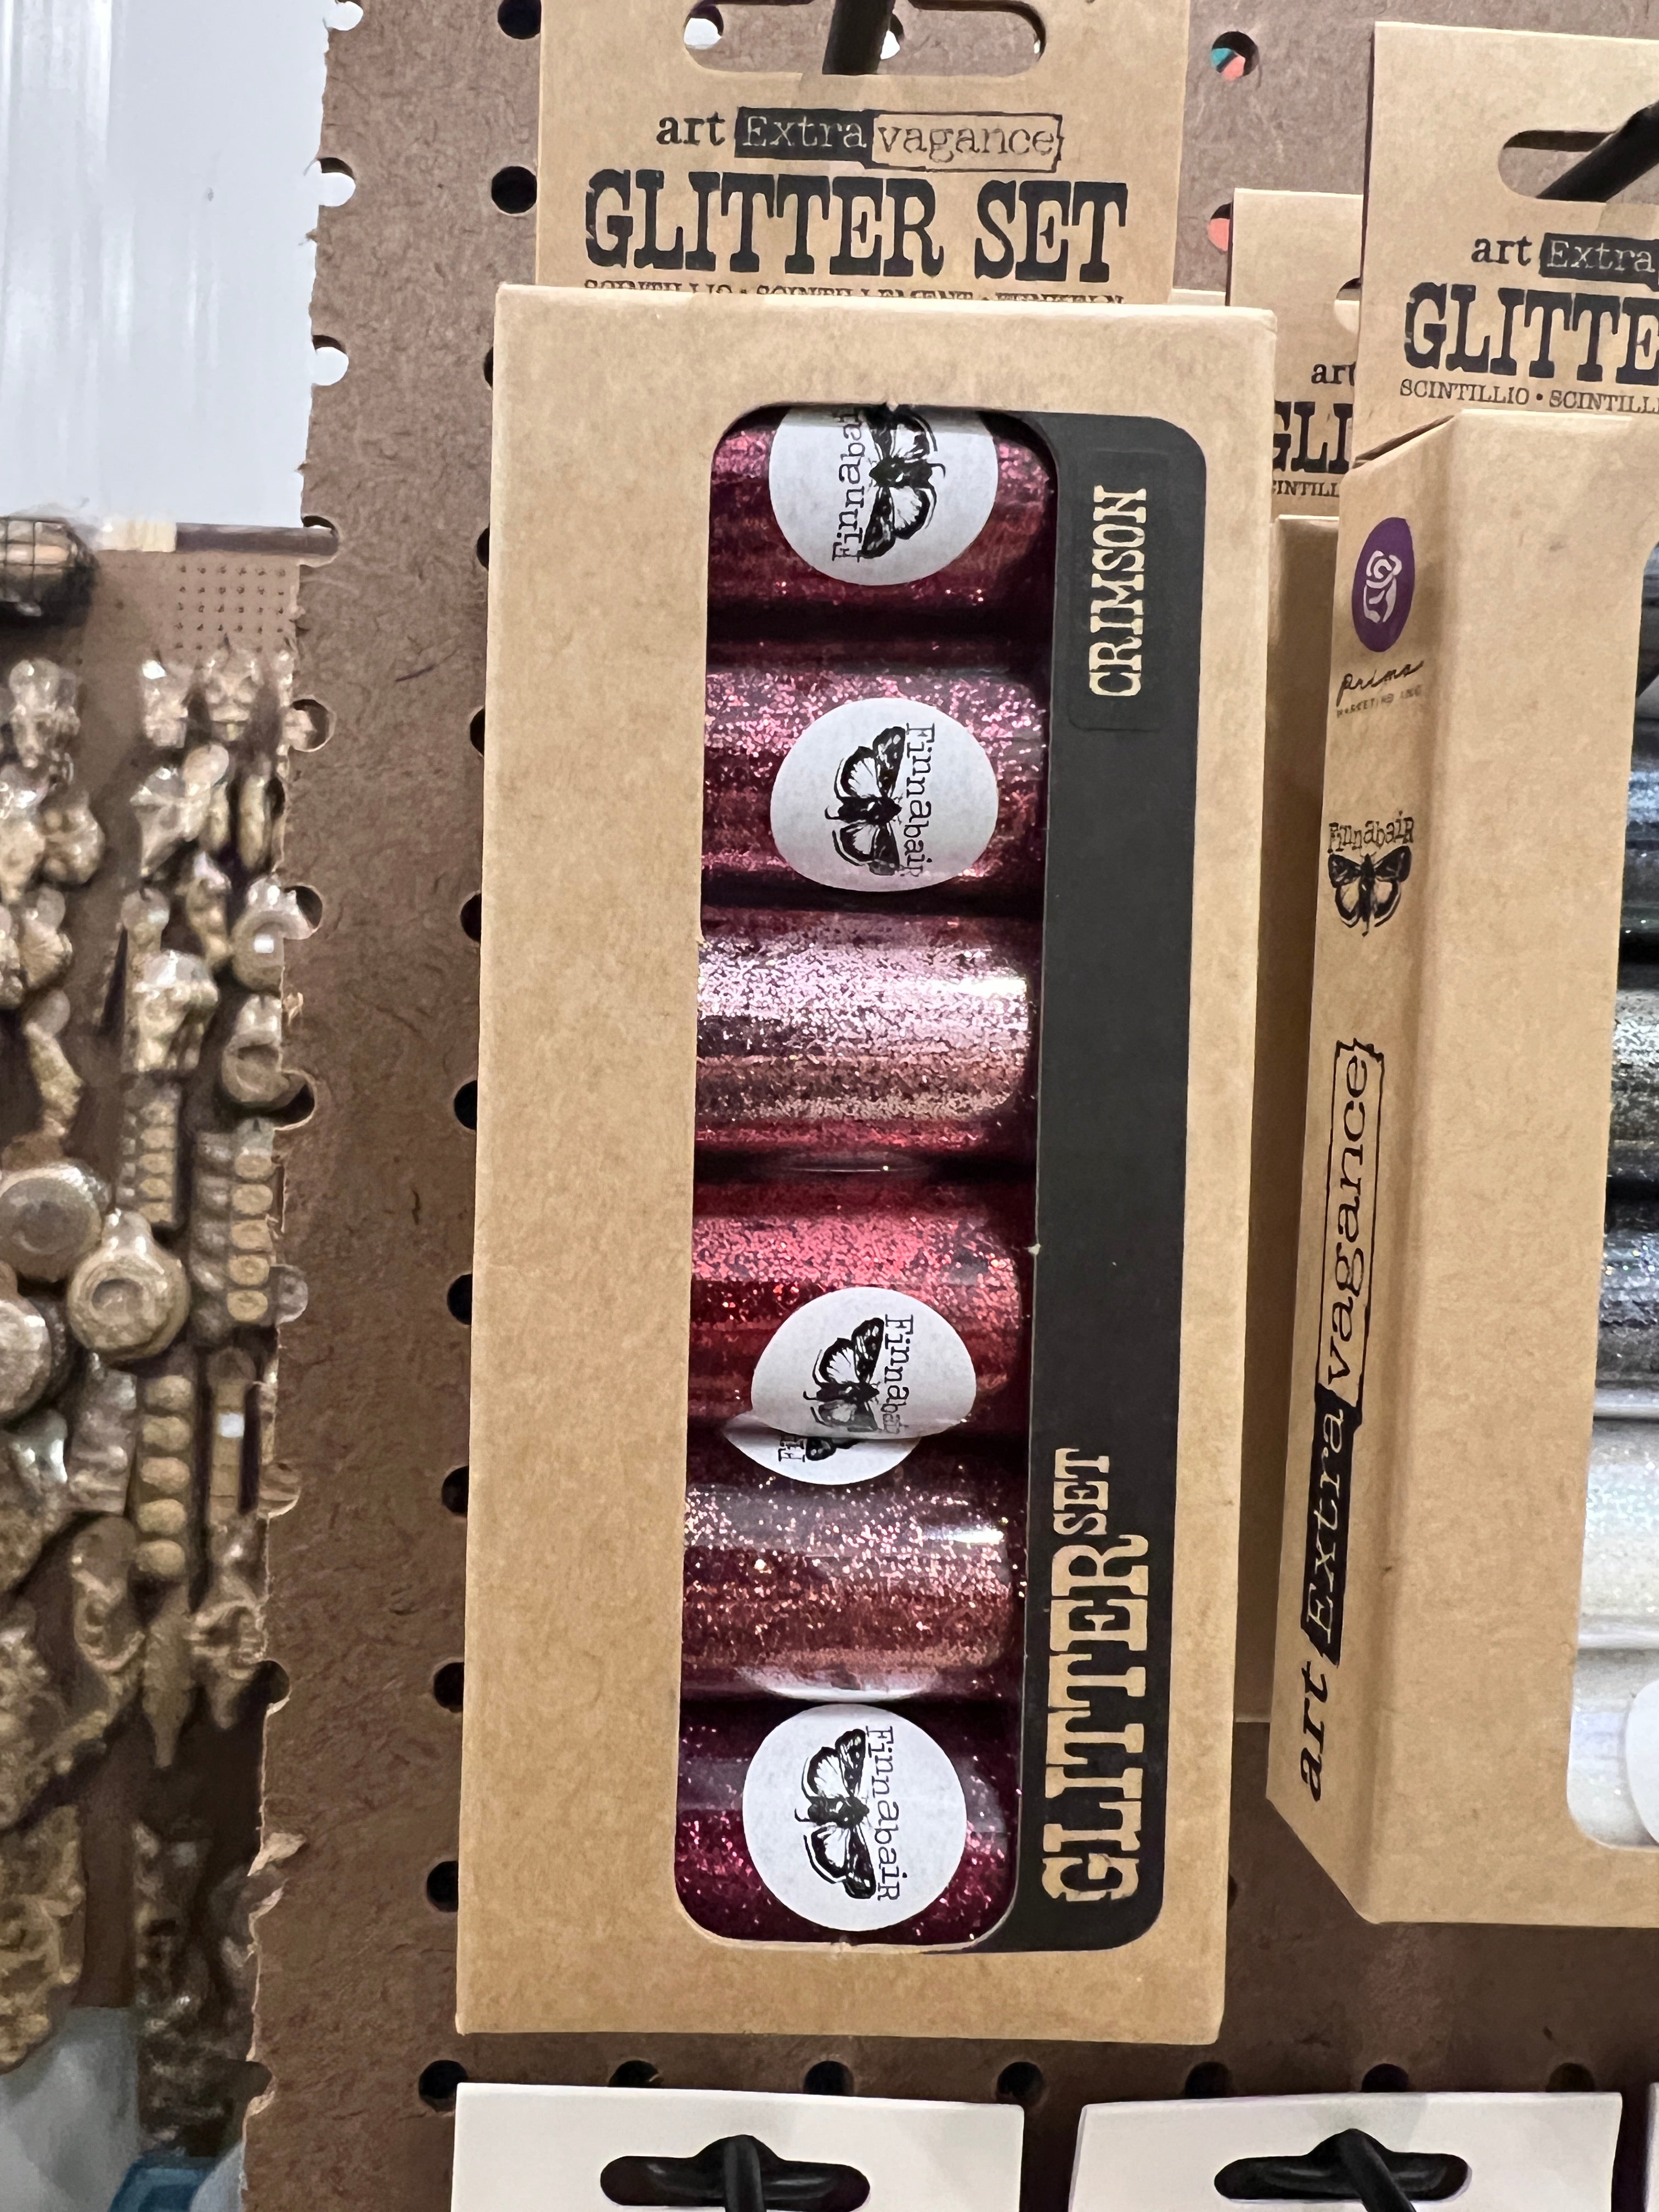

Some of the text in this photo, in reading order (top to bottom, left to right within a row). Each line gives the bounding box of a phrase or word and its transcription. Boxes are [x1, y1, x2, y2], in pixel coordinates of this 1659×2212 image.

[657, 112, 725, 147] art
[585, 168, 1128, 283] GLITTER SET
[1471, 235, 1533, 266] art
[1404, 281, 1659, 386] GLITTE
[1400, 378, 1659, 415] SCINTILLIO SCINTILL
[1088, 484, 1147, 697] CRIMSON
[1042, 1448, 1149, 1902] GLITTER SET
[1300, 1660, 1329, 1802] art
